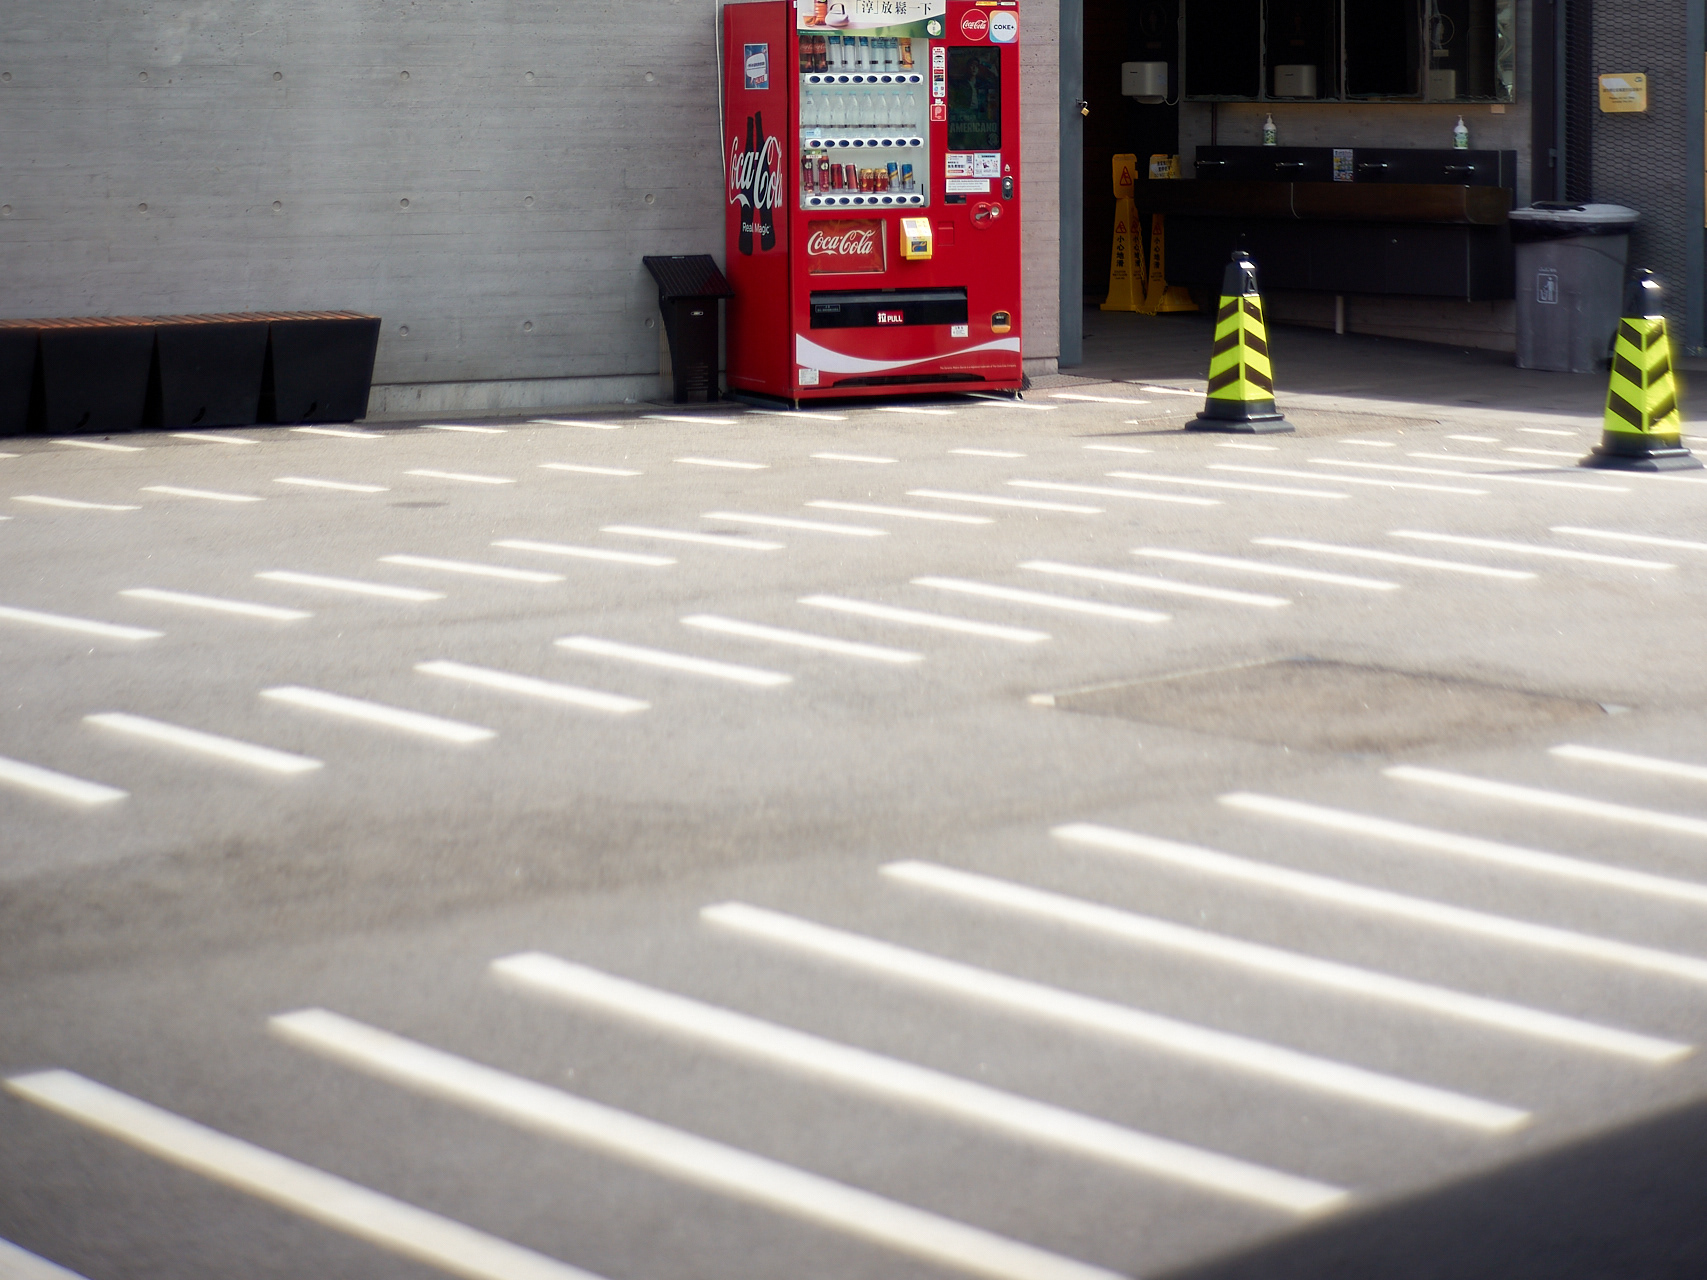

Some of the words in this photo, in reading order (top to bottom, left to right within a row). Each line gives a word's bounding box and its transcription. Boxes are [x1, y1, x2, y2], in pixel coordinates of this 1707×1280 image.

[729, 136, 783, 210] Coca-Cola
[742, 221, 754, 233] Real
[807, 229, 876, 256] Coca-Cola
[1116, 235, 1125, 267] 小心地滑
[878, 312, 887, 323] 拉
[887, 315, 903, 323] PULL
